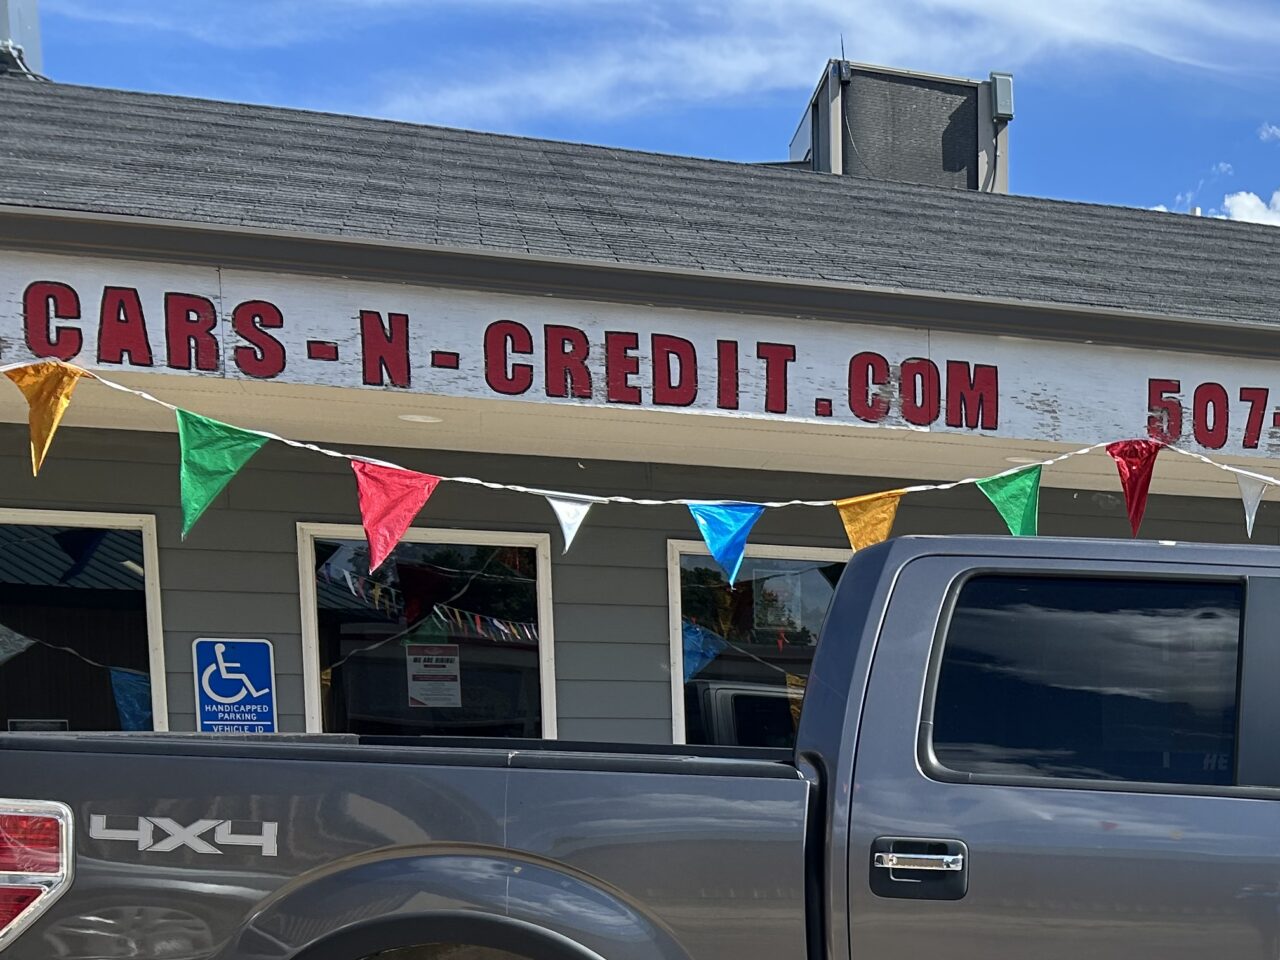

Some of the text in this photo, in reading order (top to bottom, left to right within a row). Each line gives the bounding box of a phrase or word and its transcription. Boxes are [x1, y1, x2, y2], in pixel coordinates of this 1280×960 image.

[204, 704, 269, 713] HANDICAPPED
[218, 713, 257, 721] PARKING
[212, 725, 264, 733] VEHICLE ID
